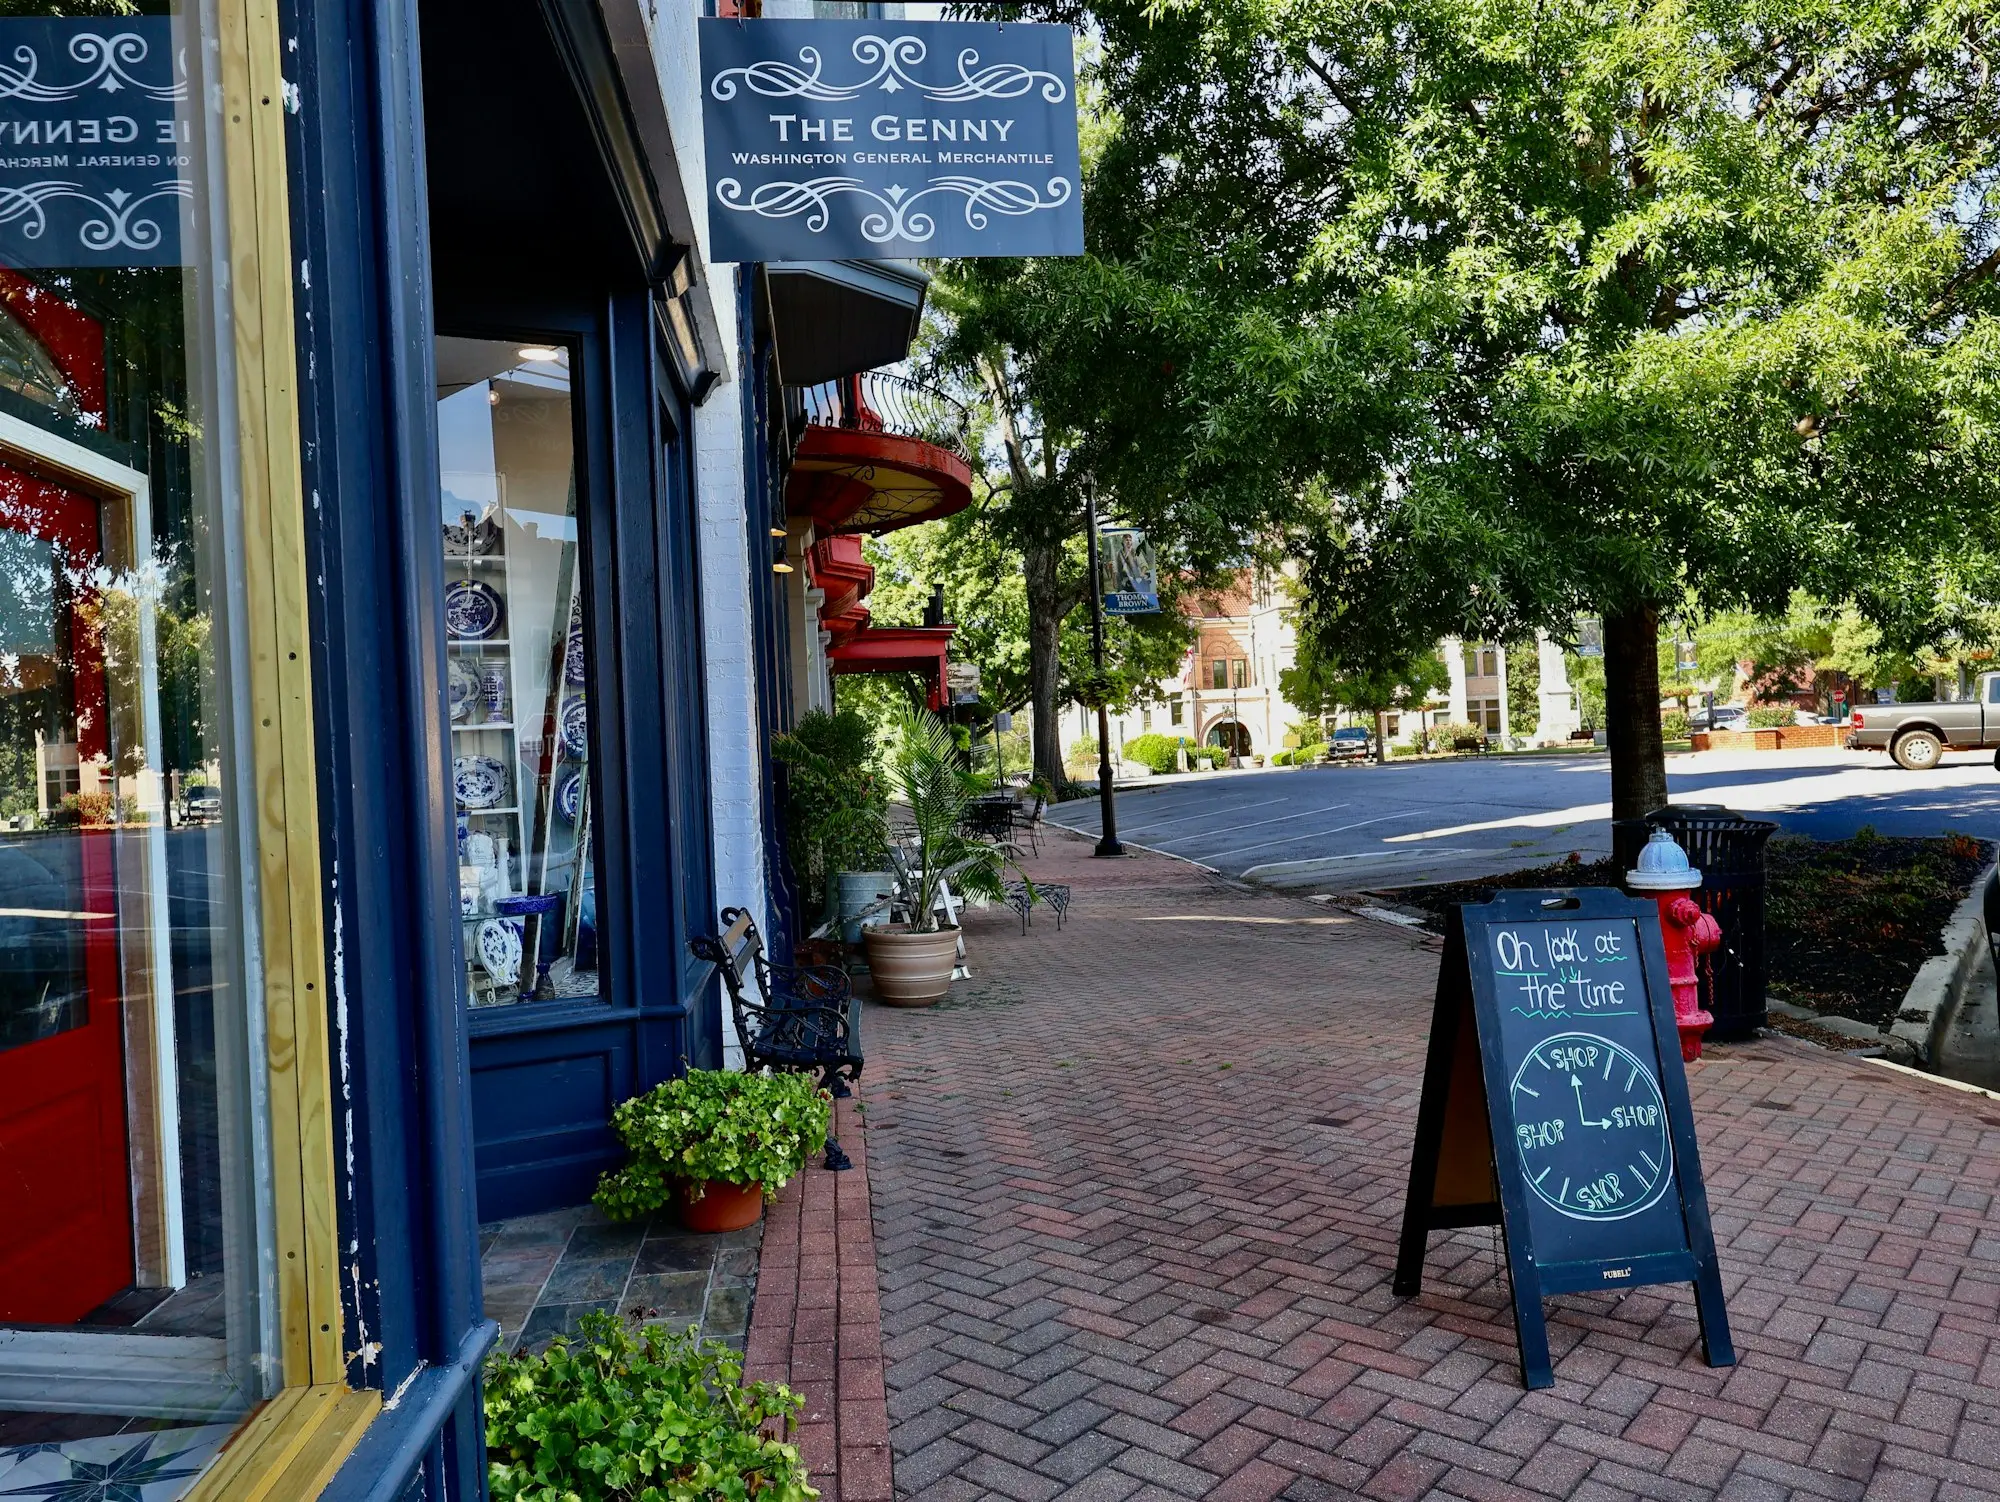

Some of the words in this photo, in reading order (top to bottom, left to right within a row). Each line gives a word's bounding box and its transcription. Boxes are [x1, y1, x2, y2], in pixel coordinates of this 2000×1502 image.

[769, 114, 854, 142] THE
[870, 114, 1015, 142] GENNY
[731, 152, 847, 166] WASHINGTON
[852, 151, 932, 165] GENERAL
[938, 151, 1054, 165] MERCHANTILE
[1496, 929, 1539, 970] Oh
[1544, 927, 1588, 969] look
[1594, 931, 1621, 954] at
[1519, 974, 1566, 1010] the
[1569, 969, 1626, 1009] time
[1551, 1046, 1599, 1072] SHOP
[1611, 1105, 1658, 1129] SHOP
[1517, 1119, 1565, 1149] SHOP
[1576, 1173, 1625, 1210] SHOP
